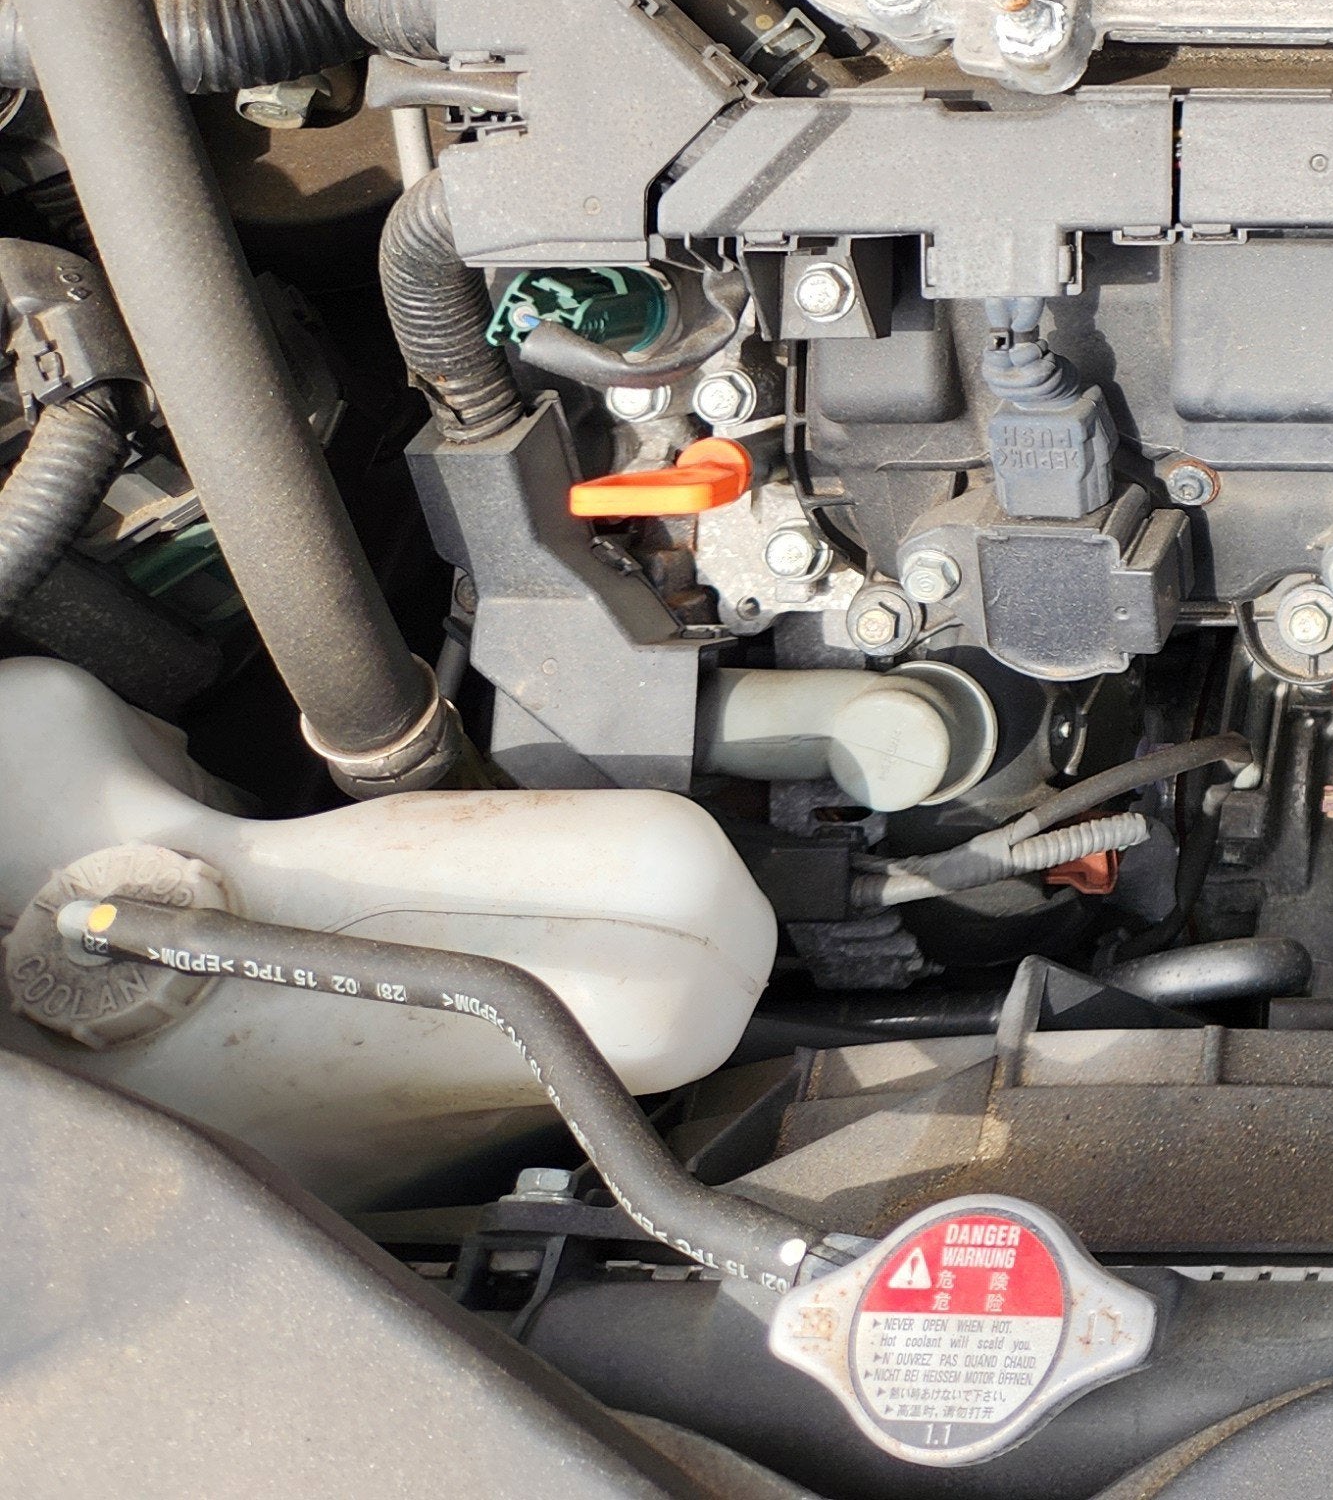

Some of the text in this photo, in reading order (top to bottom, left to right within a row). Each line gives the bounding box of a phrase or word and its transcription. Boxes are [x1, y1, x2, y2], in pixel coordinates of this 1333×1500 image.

[1003, 426, 1073, 449] PUSH
[147, 947, 236, 973] >EPDM<
[242, 959, 287, 984] TPC
[292, 968, 318, 988] 15
[14, 954, 152, 1021] COOLAN
[945, 1223, 1022, 1246] DANGER
[941, 1246, 1017, 1269] WARNUNG
[724, 1259, 749, 1279] 15
[935, 1269, 956, 1290] 危
[931, 1291, 952, 1312] 危
[883, 1317, 1013, 1334] NEVER OPEN WHEN HOT.
[879, 1335, 1032, 1353] Hot coolant will scald you.
[896, 1352, 933, 1367] OUVREZ
[939, 1353, 959, 1367] PAS
[873, 1368, 902, 1382] NICHT
[904, 1369, 920, 1383] BEI
[923, 1370, 962, 1384] HEISSEM
[964, 1371, 995, 1385] MOTOR
[924, 1422, 953, 1446] 1.1
